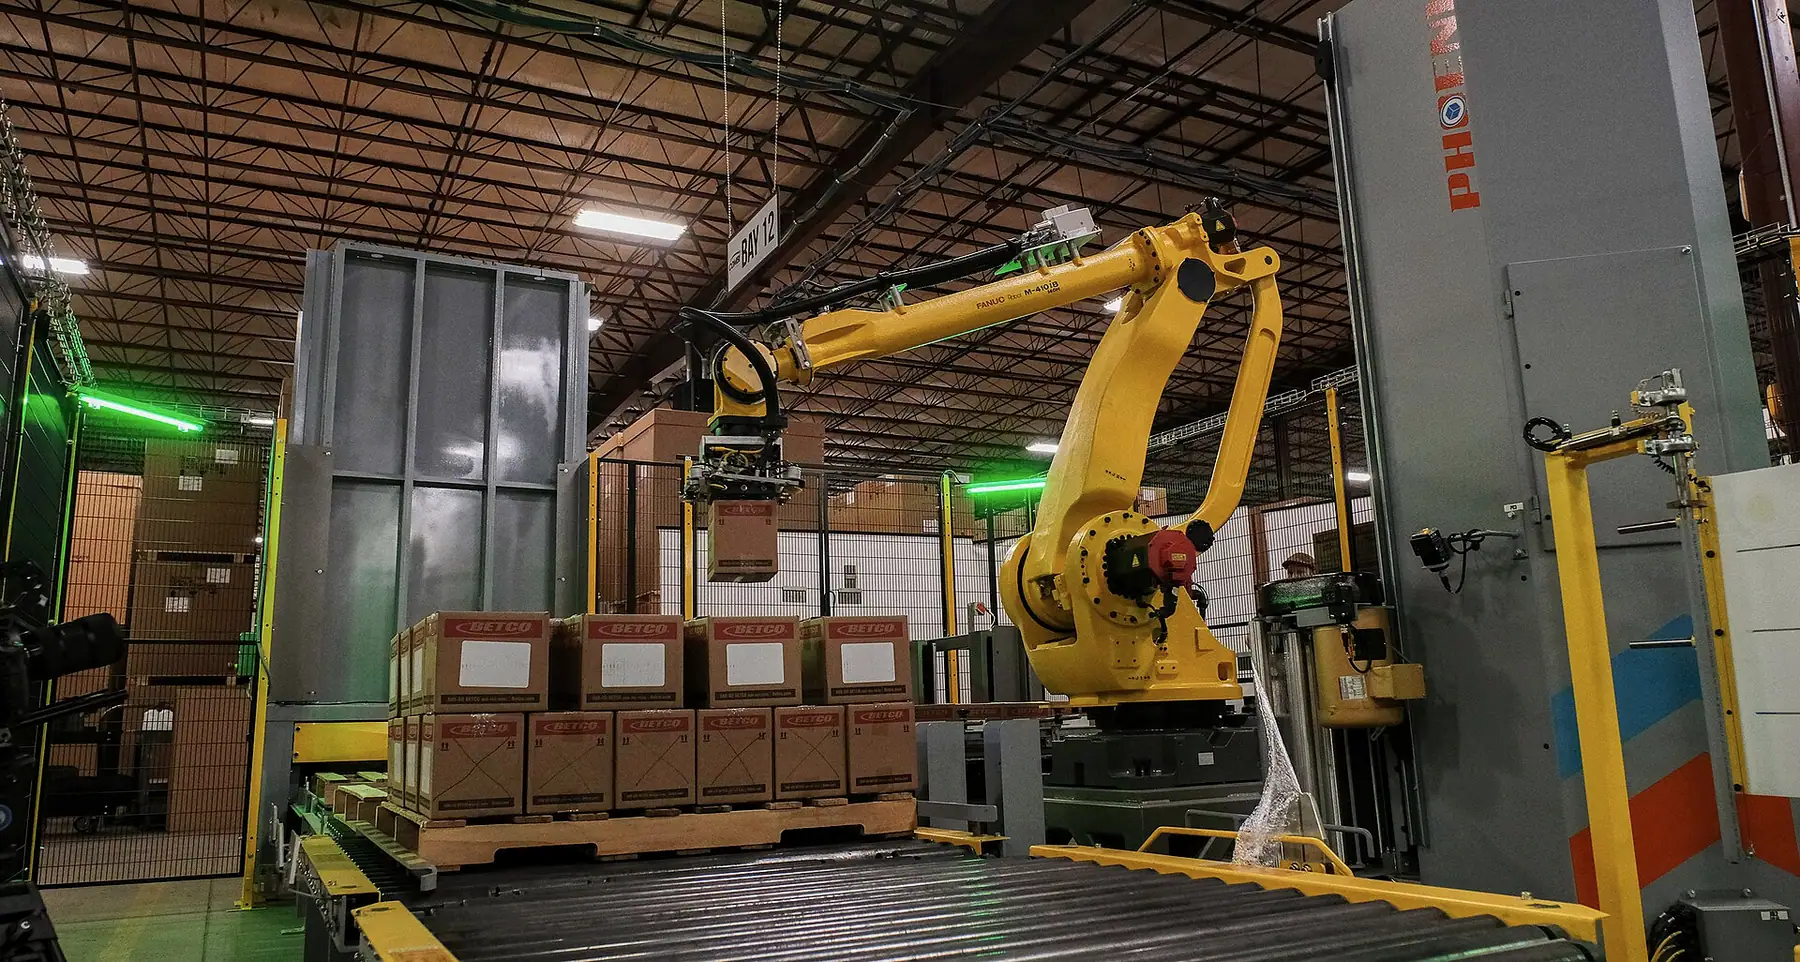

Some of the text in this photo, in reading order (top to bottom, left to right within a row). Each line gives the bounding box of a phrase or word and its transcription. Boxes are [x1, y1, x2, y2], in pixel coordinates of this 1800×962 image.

[741, 224, 760, 269] BAY
[763, 211, 775, 247] 12
[976, 296, 1005, 310] FANUC
[469, 621, 532, 633] BETCO
[610, 623, 668, 633] BETCO
[734, 624, 786, 634] BETCO
[847, 623, 895, 633] BETCO
[795, 714, 833, 723] BETCO
[868, 710, 904, 719] BETCO
[553, 721, 599, 730] BETCO
[639, 718, 682, 728] BETCO
[718, 717, 758, 726] BETCO
